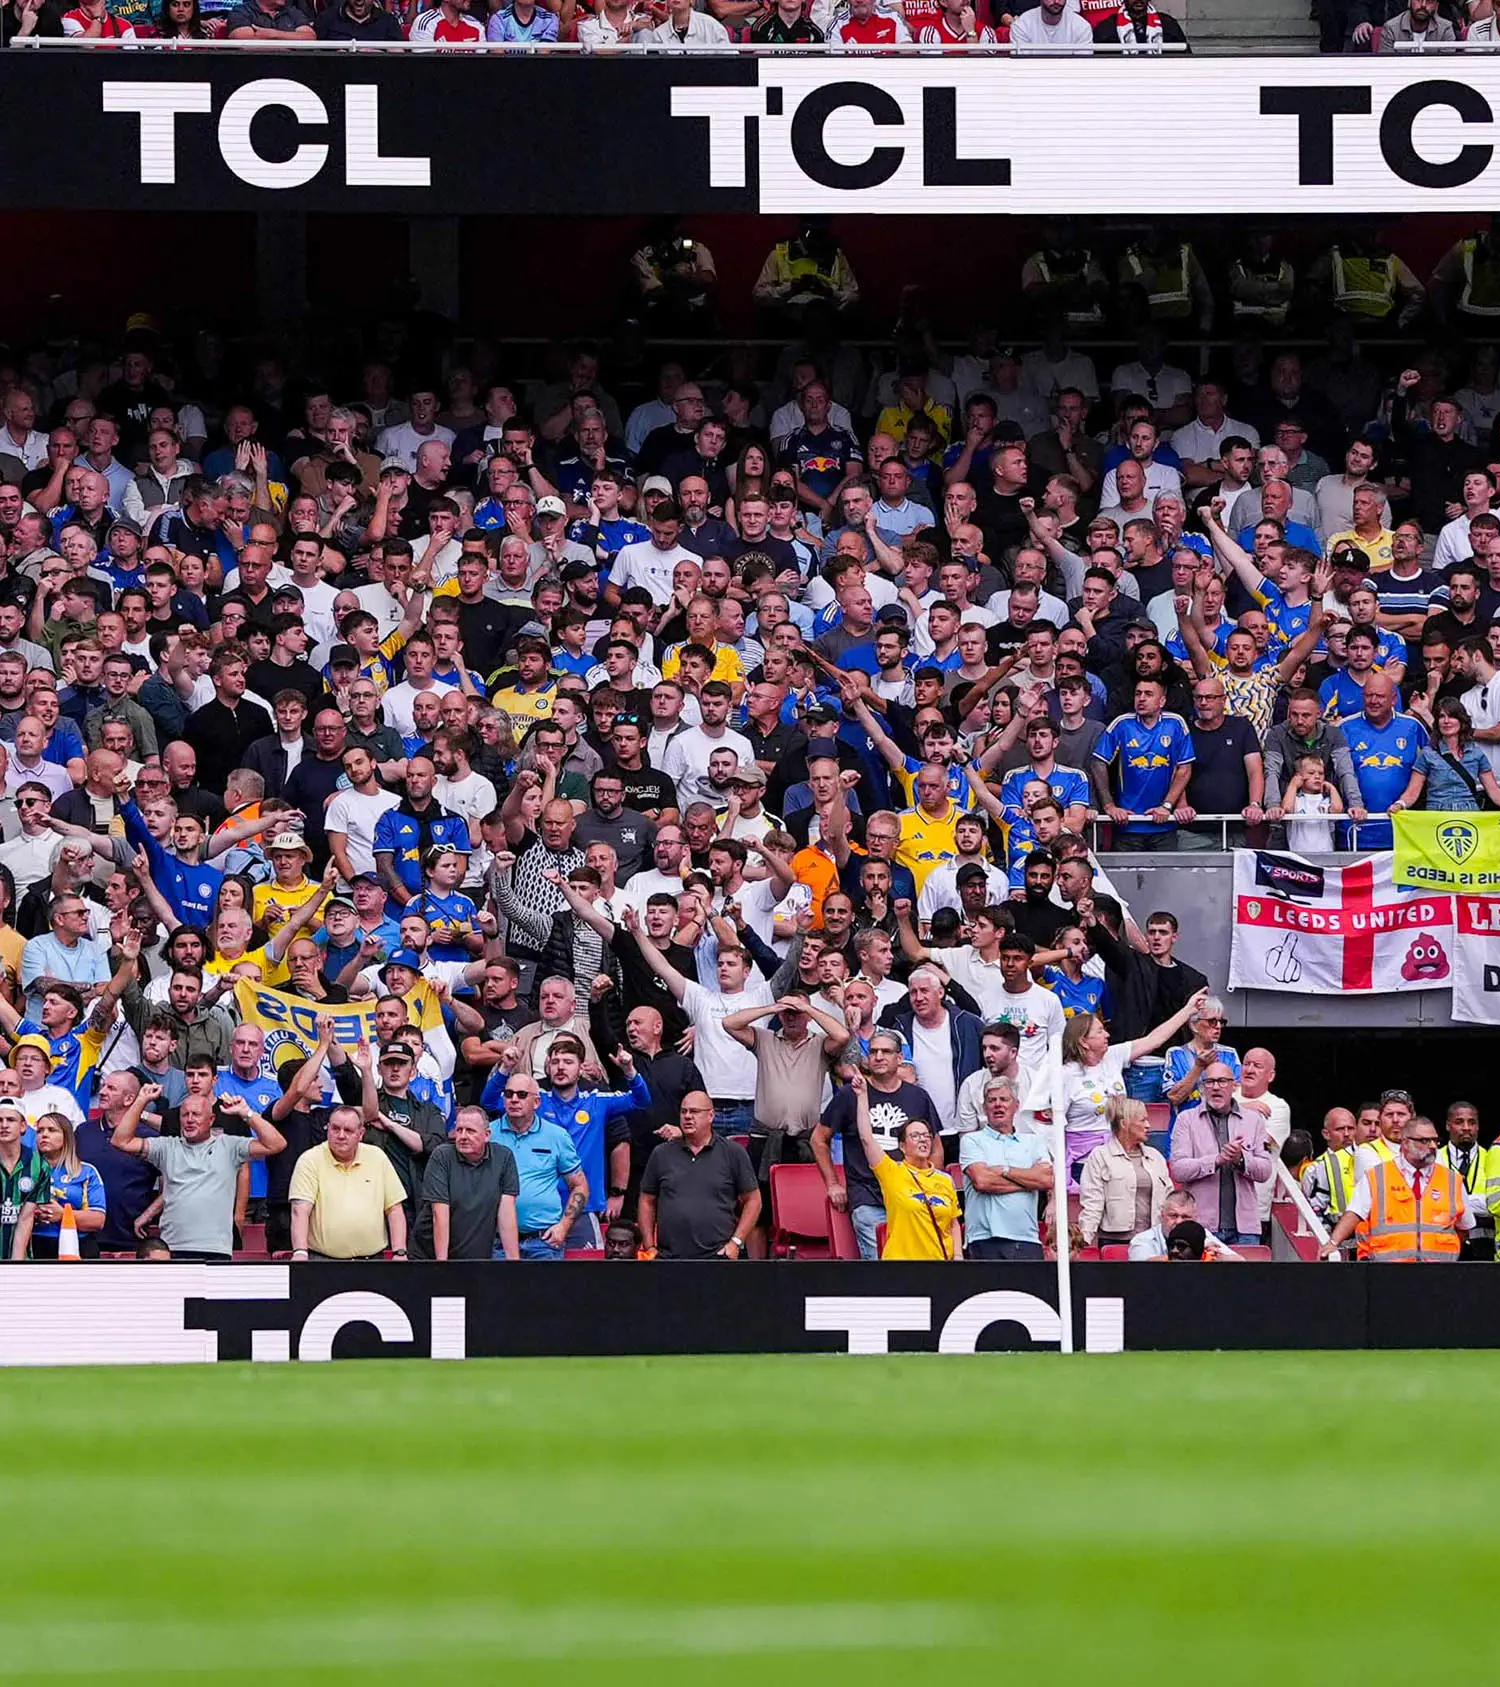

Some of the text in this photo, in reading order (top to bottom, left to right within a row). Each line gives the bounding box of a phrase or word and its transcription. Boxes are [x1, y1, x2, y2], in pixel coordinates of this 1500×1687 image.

[103, 78, 431, 189] TCL
[671, 80, 1010, 190] TCL
[1271, 866, 1321, 884] SPORTS
[1273, 904, 1435, 930] LEEDS UNITED
